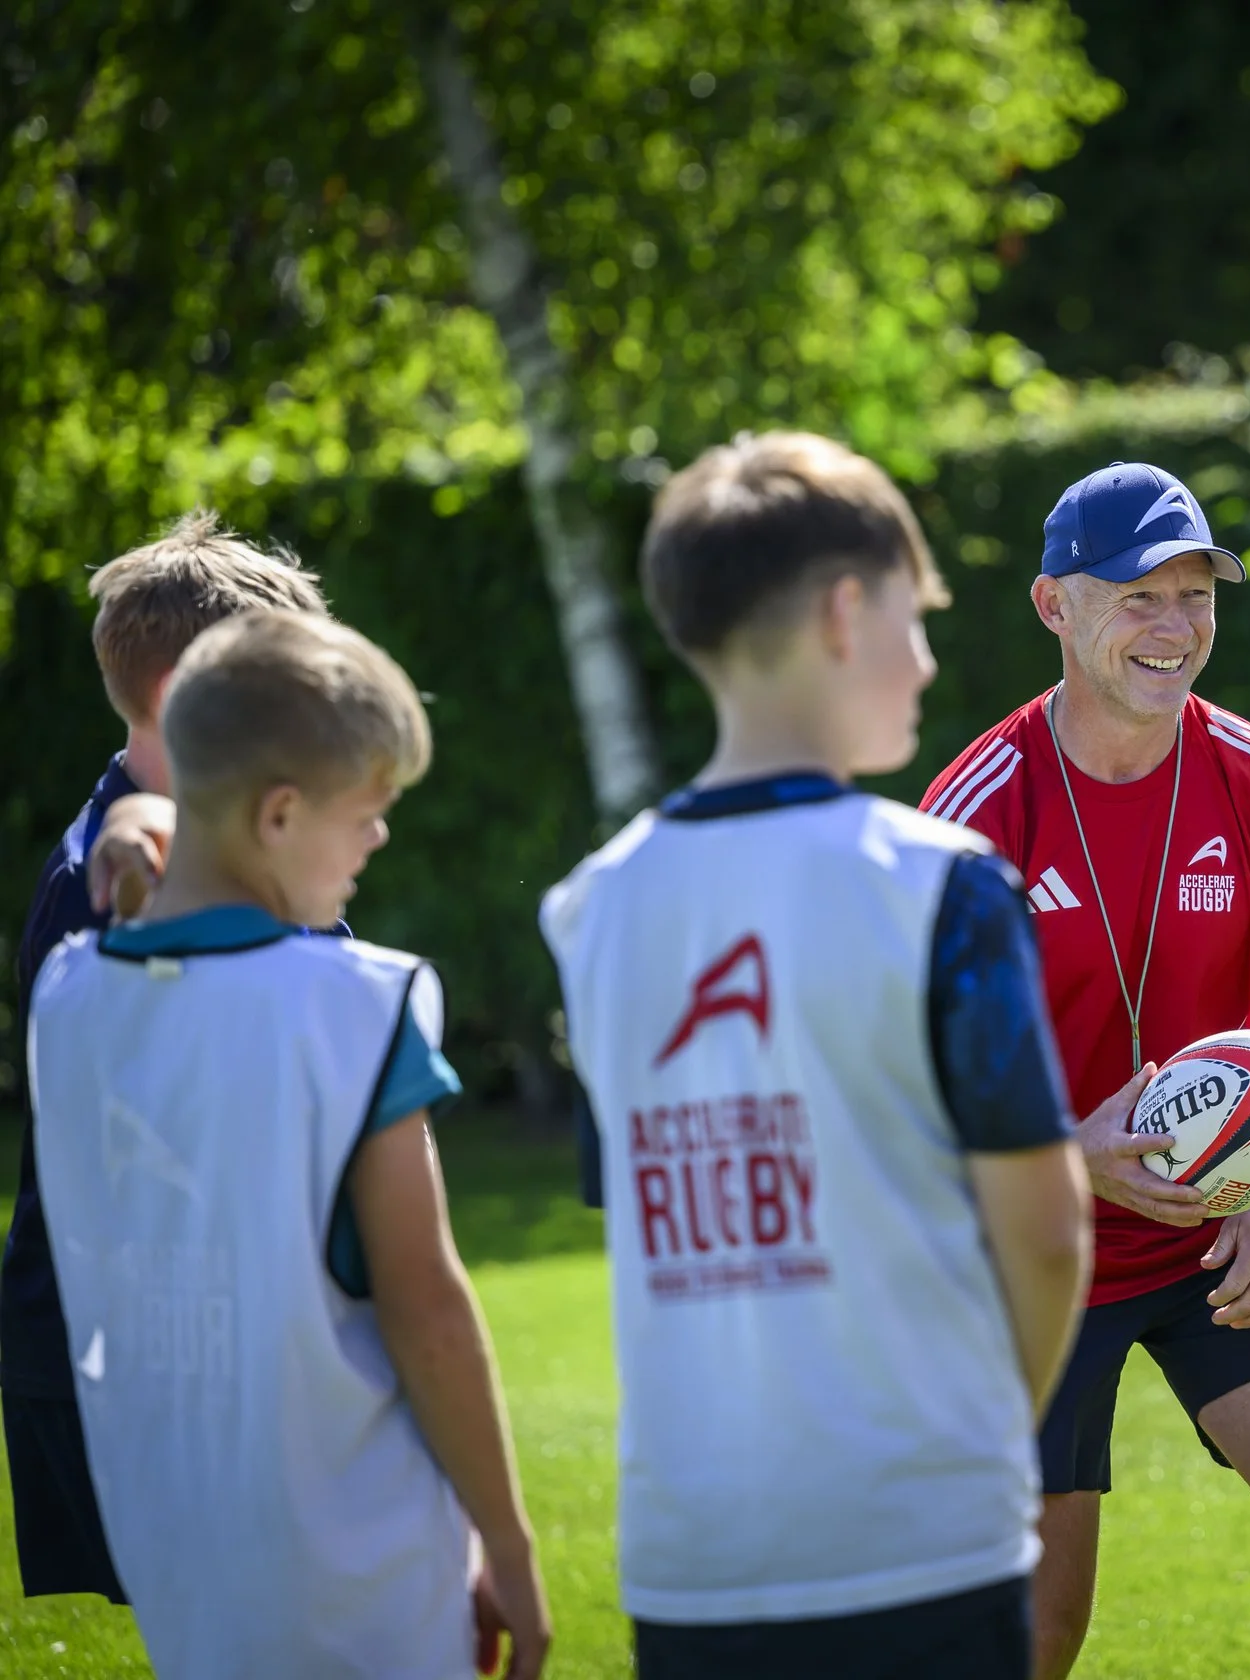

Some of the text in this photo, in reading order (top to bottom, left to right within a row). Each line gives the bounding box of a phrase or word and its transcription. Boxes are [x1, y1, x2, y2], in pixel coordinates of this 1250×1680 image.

[1179, 874, 1236, 889] ACCELERATE
[1178, 887, 1236, 912] RUGBY
[637, 1151, 816, 1258] RUGBY
